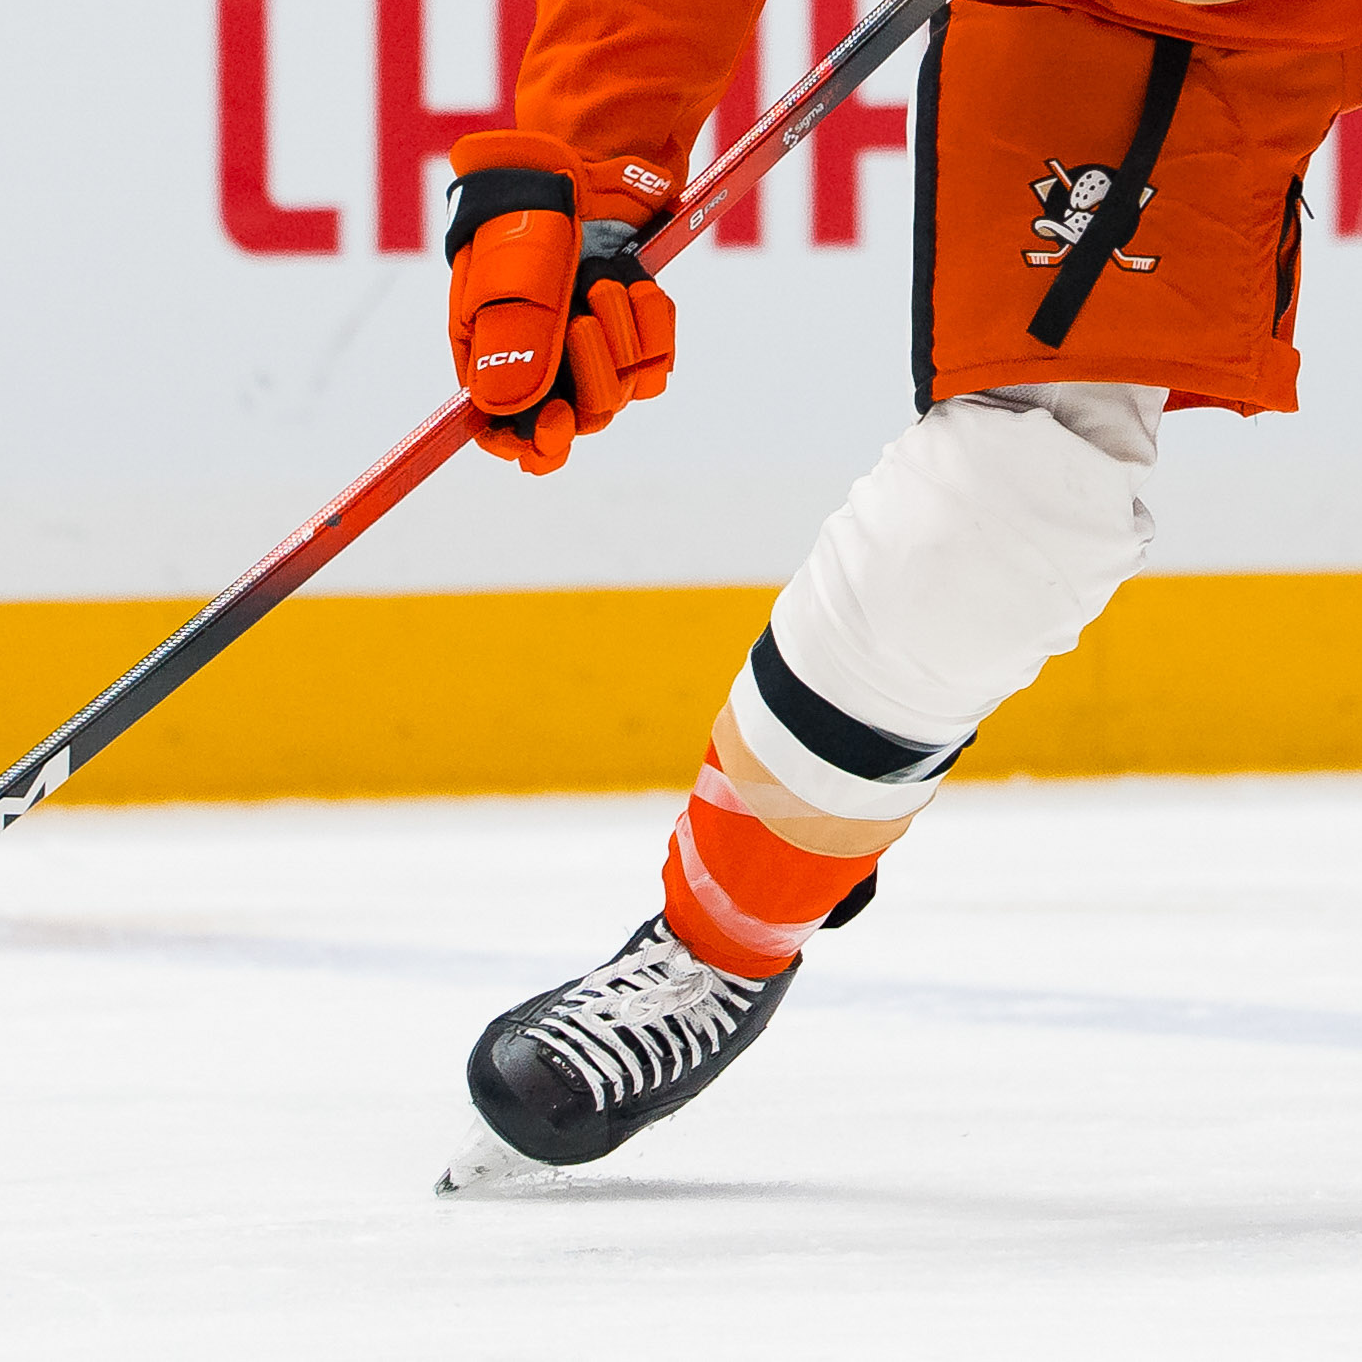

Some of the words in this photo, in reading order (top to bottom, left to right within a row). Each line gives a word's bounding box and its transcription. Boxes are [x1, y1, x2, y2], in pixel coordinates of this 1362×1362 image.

[794, 102, 825, 134] sigma
[623, 163, 672, 192] CCM
[704, 189, 728, 215] PRO
[476, 349, 535, 371] CCM
